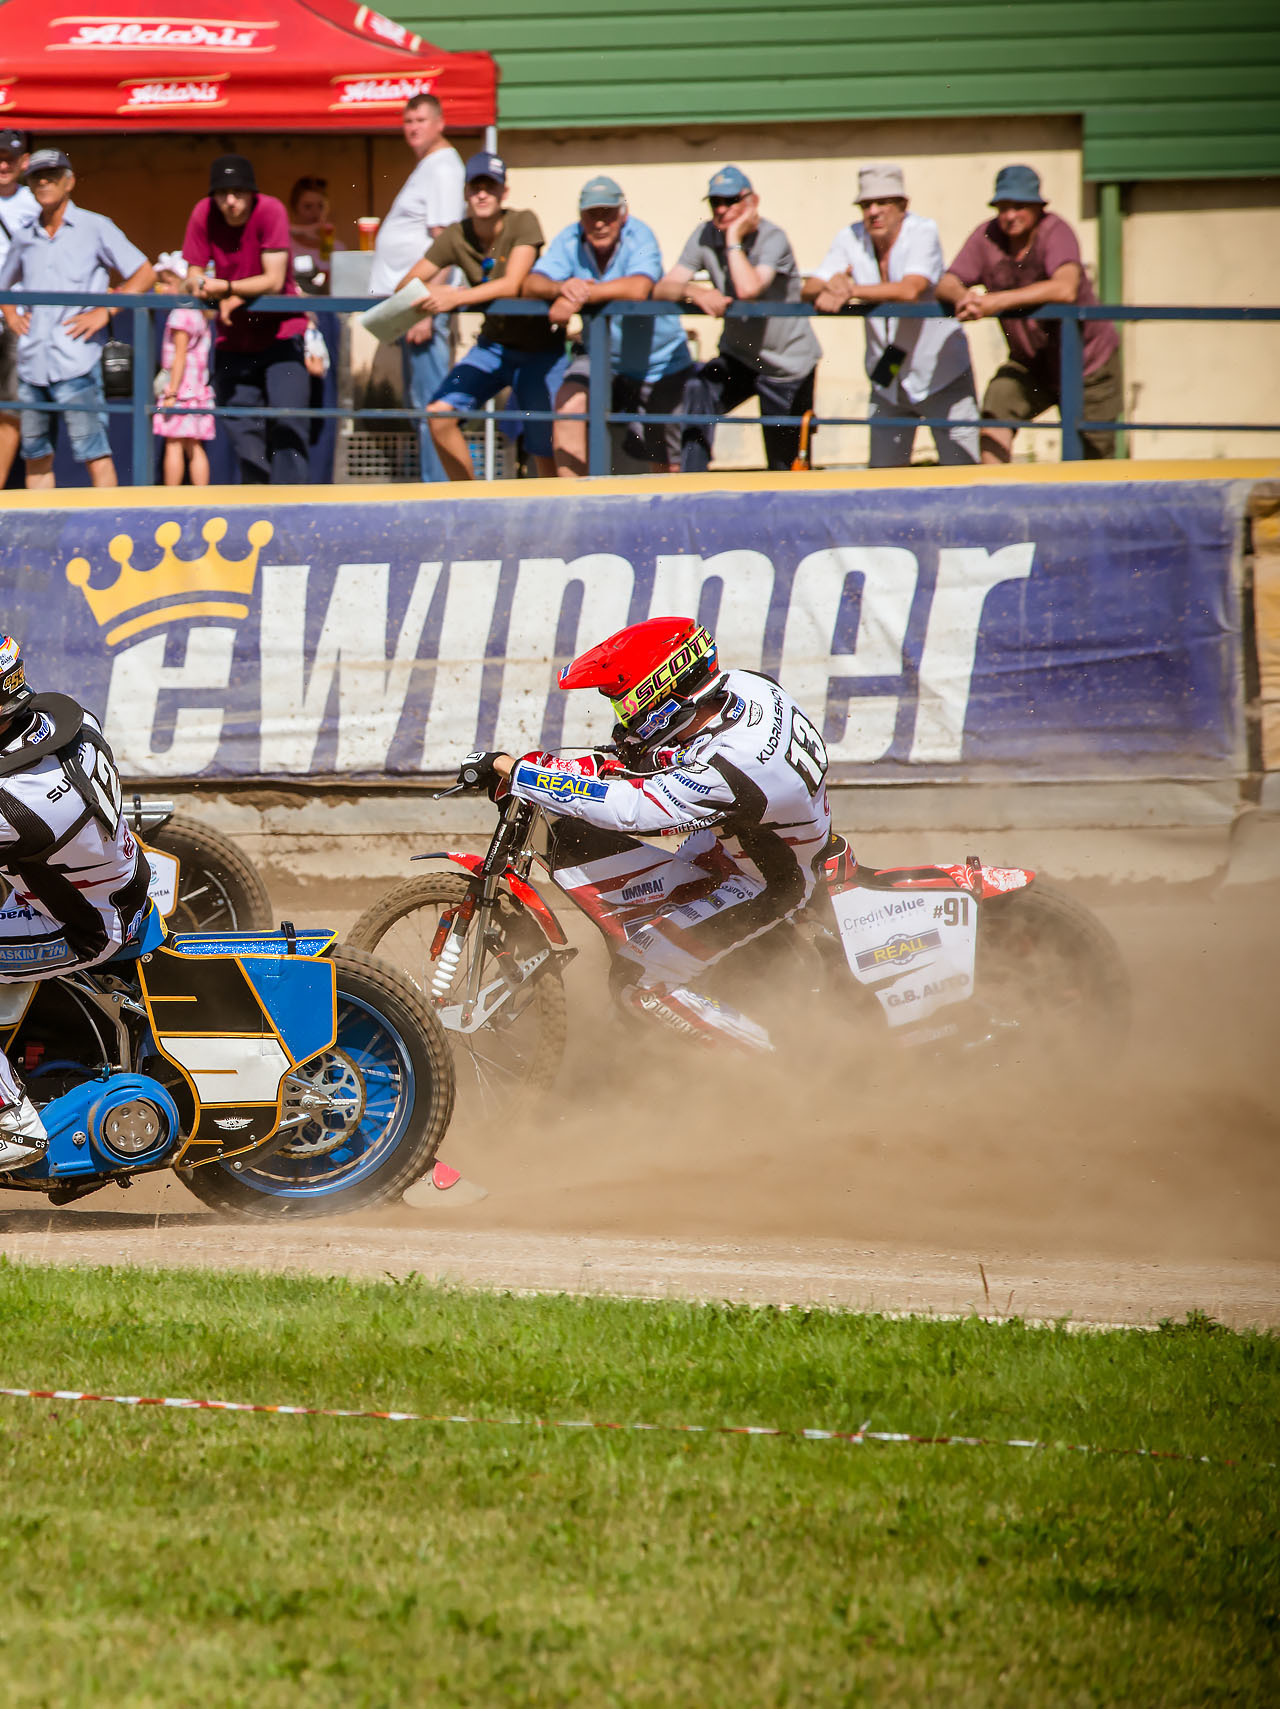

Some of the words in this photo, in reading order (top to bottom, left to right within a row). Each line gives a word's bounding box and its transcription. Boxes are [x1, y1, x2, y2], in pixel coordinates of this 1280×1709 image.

[70, 24, 257, 46] Aldaris
[128, 83, 218, 105] Aldaris
[791, 713, 827, 787] 13
[536, 773, 592, 796] REALL
[148, 889, 170, 898] CHEM
[933, 898, 969, 926] #91
[874, 937, 928, 964] REALL
